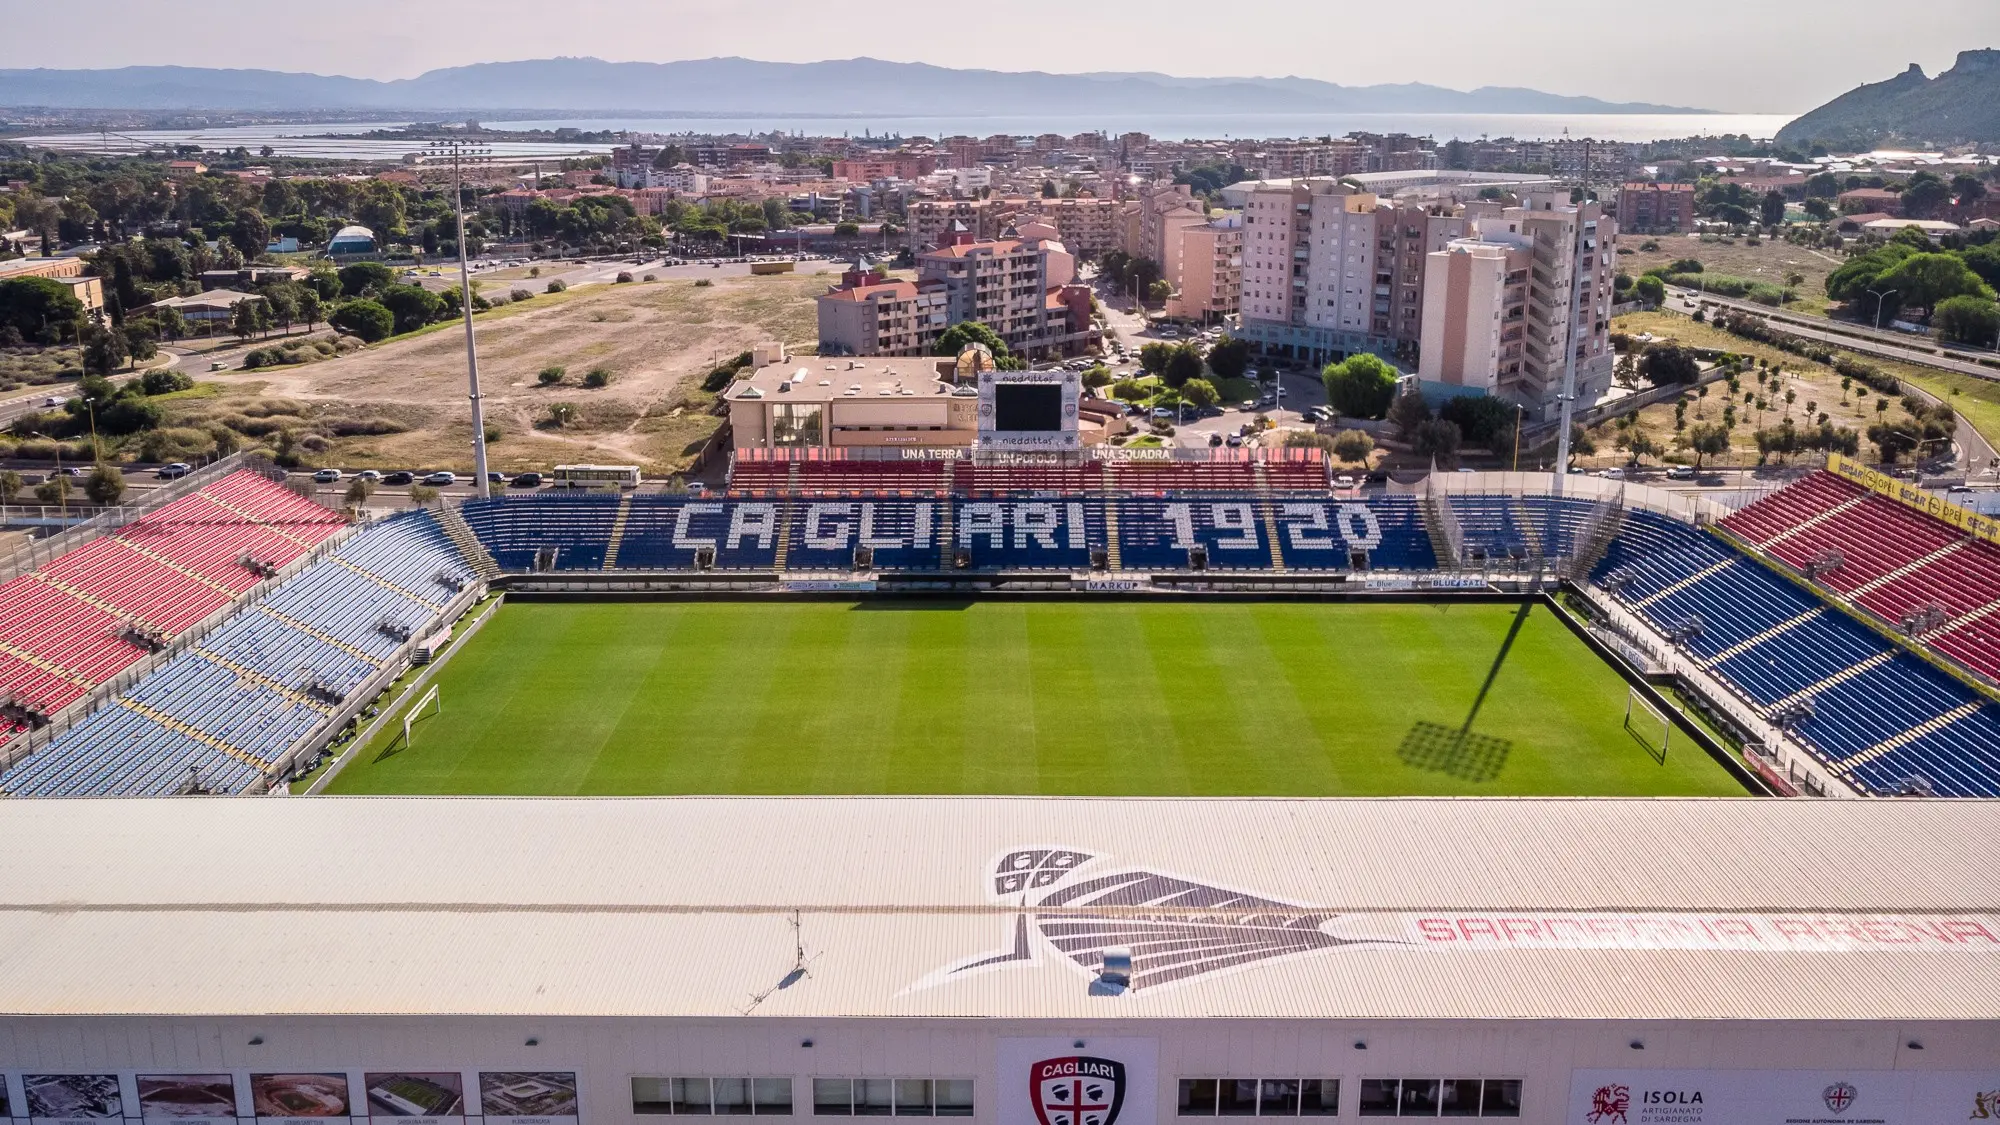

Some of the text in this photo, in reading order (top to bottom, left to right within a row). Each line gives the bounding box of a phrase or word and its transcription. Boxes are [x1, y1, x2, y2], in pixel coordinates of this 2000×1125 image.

[1002, 374, 1052, 382] nieddittas
[1002, 436, 1052, 445] nieddittas
[902, 449, 964, 459] UNA TERRA
[999, 454, 1057, 464] UN POPOLO
[1092, 449, 1170, 460] UNA SQUADRA
[1839, 462, 1863, 480] SECAR
[1878, 479, 1895, 494] OPEL
[1900, 487, 1926, 506] SECAR
[1944, 506, 1961, 522] OPEL
[672, 503, 1382, 549] CAGLIARI 1920
[1967, 516, 1997, 537] SECAR
[1089, 582, 1138, 590] MARKUP
[1773, 919, 2000, 943] ARENA
[1042, 1062, 1115, 1078] CAGLIARI
[1643, 1091, 1703, 1104] ISOLA
[1642, 1107, 1703, 1115] ARTIGIANATO
